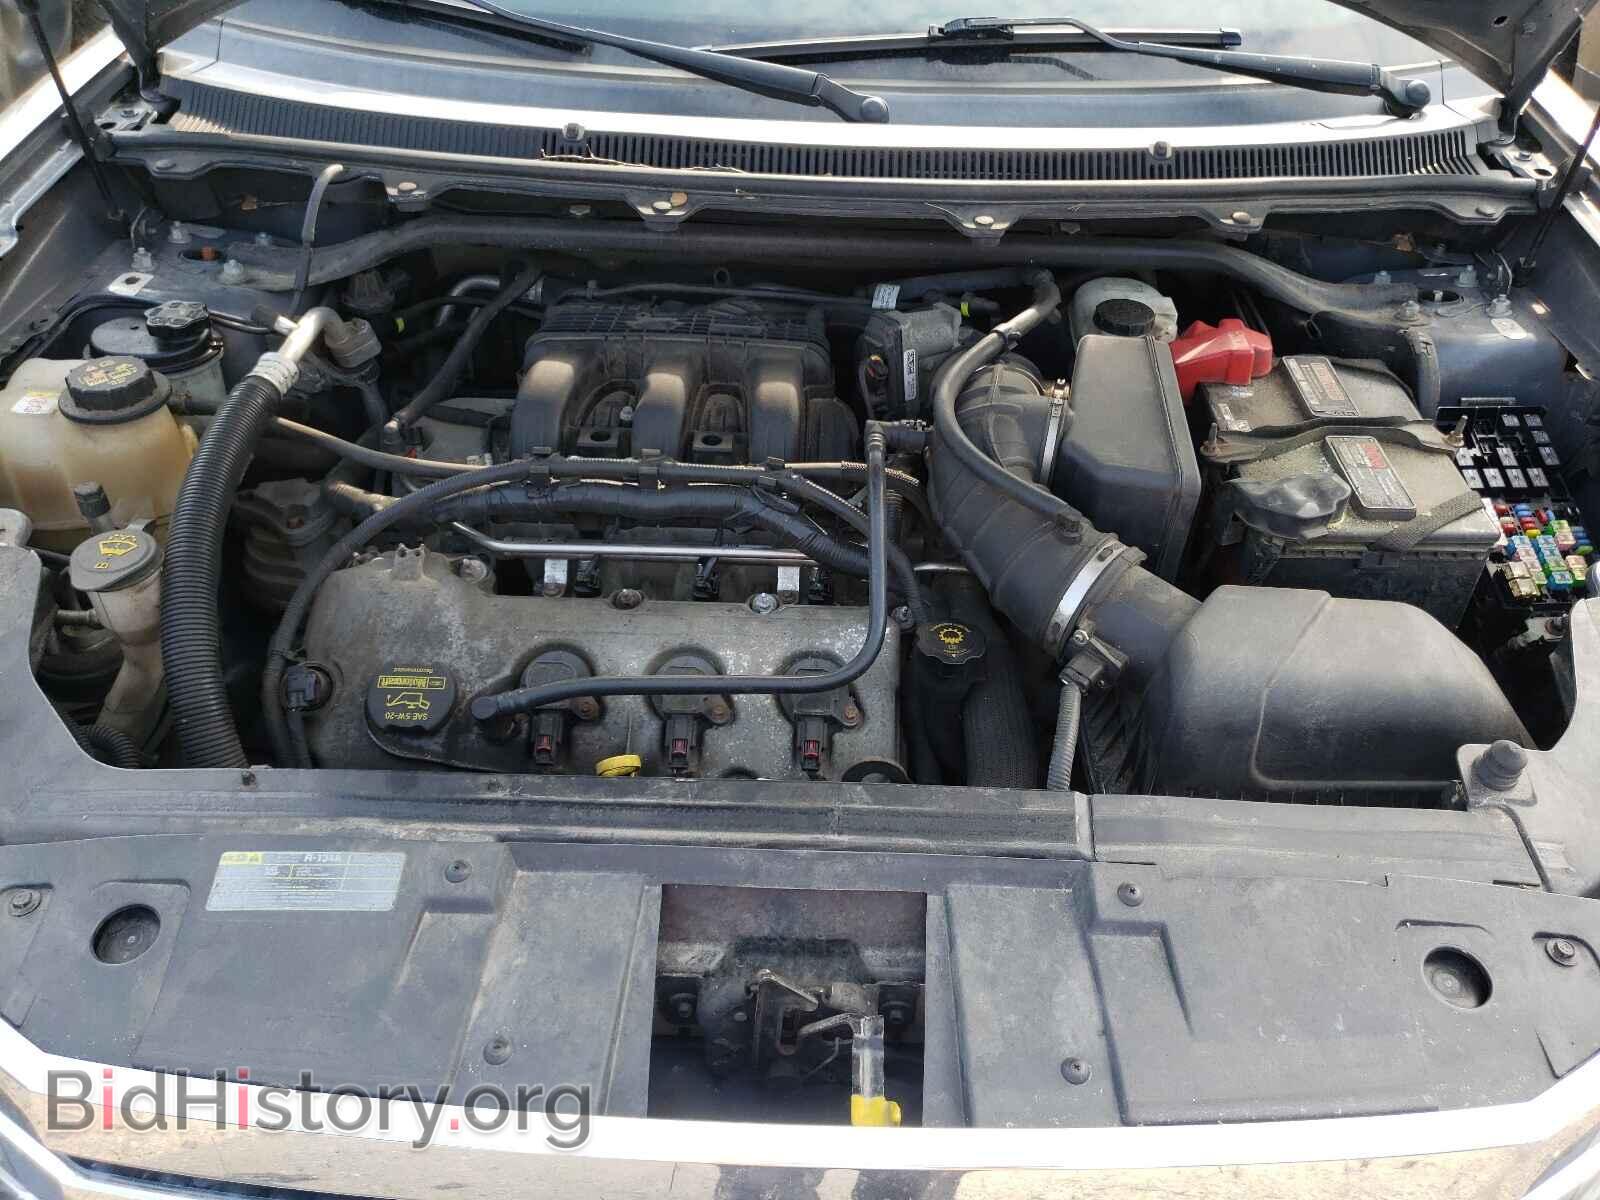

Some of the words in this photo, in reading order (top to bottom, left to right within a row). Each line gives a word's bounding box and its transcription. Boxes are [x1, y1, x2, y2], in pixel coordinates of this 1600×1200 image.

[381, 677, 427, 688] Motorcraft
[385, 711, 412, 720] 5W-20
[412, 711, 429, 720] SAE
